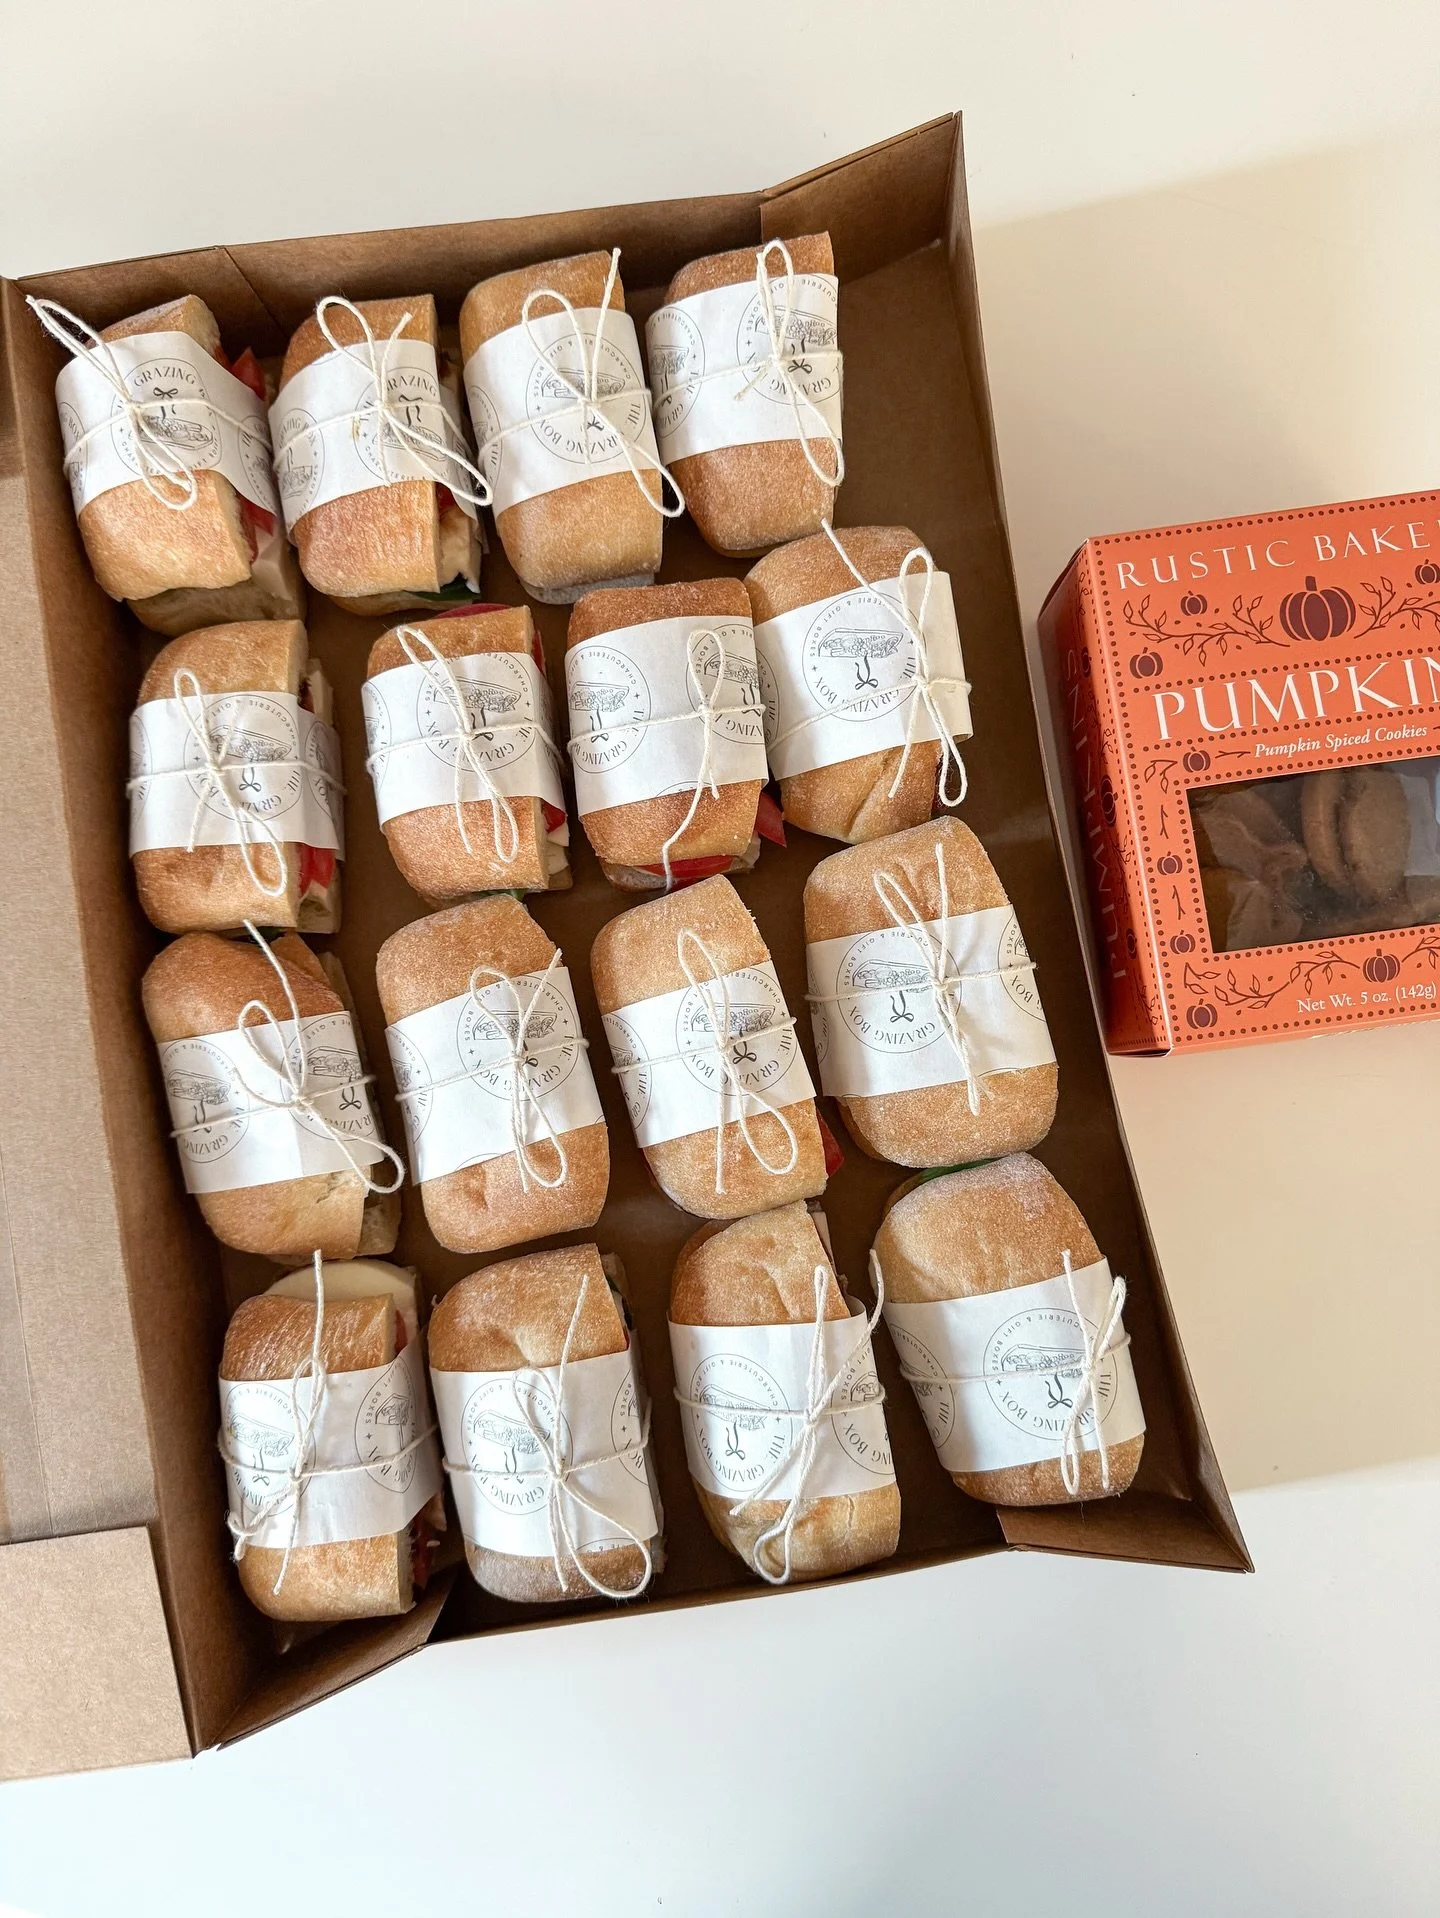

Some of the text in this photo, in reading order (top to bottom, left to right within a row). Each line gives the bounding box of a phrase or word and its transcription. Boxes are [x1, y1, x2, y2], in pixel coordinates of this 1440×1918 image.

[802, 279, 837, 306] CUTERIE
[133, 366, 197, 388] GRAZING
[386, 375, 438, 397] RAZING
[769, 377, 832, 396] GRANG
[626, 403, 641, 427] THE
[1116, 520, 1440, 590] RUSTIC BAKE
[823, 606, 842, 624] GIFT
[810, 626, 822, 657] BOXES
[486, 653, 530, 694] CHARCUTE
[588, 651, 638, 686] CHARCUTERIE
[696, 645, 711, 675] BOXES
[815, 676, 839, 705] BOX
[581, 740, 628, 765] GRAZING
[1254, 724, 1429, 758] Pumpkin Spiced Cookies
[285, 770, 301, 793] THE
[1064, 649, 1127, 981] PUMPKINS
[857, 937, 875, 954] GIFT
[1006, 923, 1018, 955] BOXES
[843, 956, 857, 987] BOXES
[726, 972, 781, 1004] CHARCUTER
[1010, 975, 1034, 1004] BOX
[1296, 981, 1437, 1014] Net Wt. 5 oz. (142g)
[465, 1010, 475, 1042] BOXES
[684, 1001, 694, 1032] BOXES
[847, 1006, 936, 1045] GRAZING BOX
[306, 1024, 327, 1041] GIFT
[778, 1028, 793, 1054] THE
[637, 1073, 648, 1096] THE
[1002, 1321, 1021, 1338] GIFT
[702, 1361, 717, 1376] GIFT
[991, 1340, 1003, 1372] BOXES
[729, 1360, 779, 1407] CHARCUTERIE
[840, 1368, 856, 1401] BOXES
[365, 1390, 382, 1425] BOXES
[619, 1382, 633, 1418] BOXES
[938, 1402, 950, 1426] THE
[1000, 1373, 1112, 1432] THE GRZING BOX
[842, 1423, 869, 1455] BOX
[699, 1427, 786, 1483] THE GRAZING BOX
[490, 1485, 545, 1507] GRAZING
